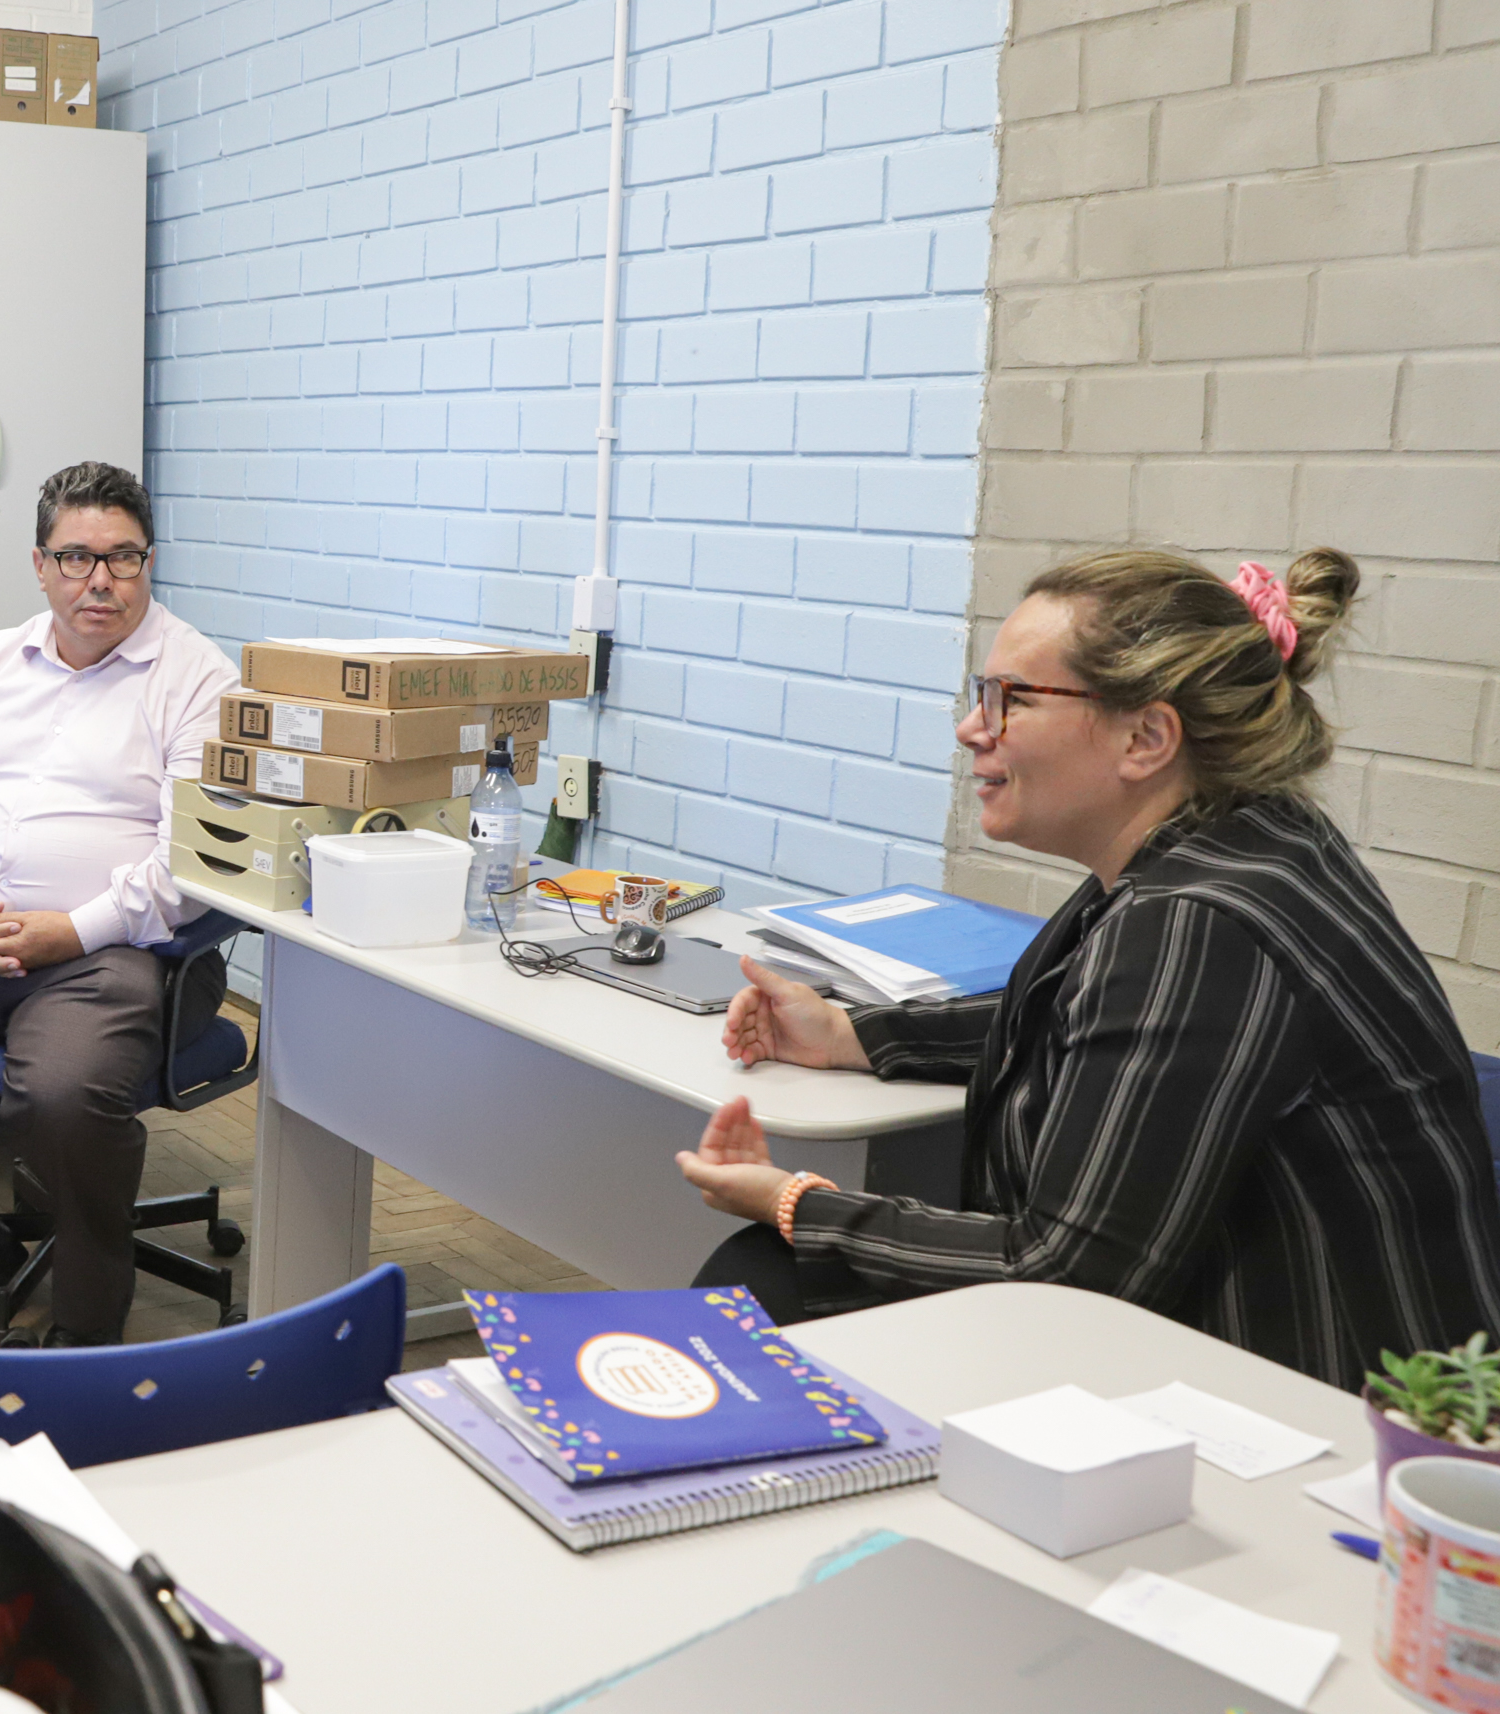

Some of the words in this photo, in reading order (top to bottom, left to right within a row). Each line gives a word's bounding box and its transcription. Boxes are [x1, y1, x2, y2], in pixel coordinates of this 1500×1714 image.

[354, 670, 362, 692] intel
[399, 666, 443, 700] EMEF
[449, 666, 514, 698] MACDO
[519, 669, 534, 694] DE
[539, 666, 579, 694] ASSIS
[490, 705, 541, 735] 135520
[228, 756, 236, 776] intel
[688, 1336, 719, 1362] 2022
[645, 1349, 697, 1401] MACHADO
[712, 1362, 761, 1402] AGENDA
